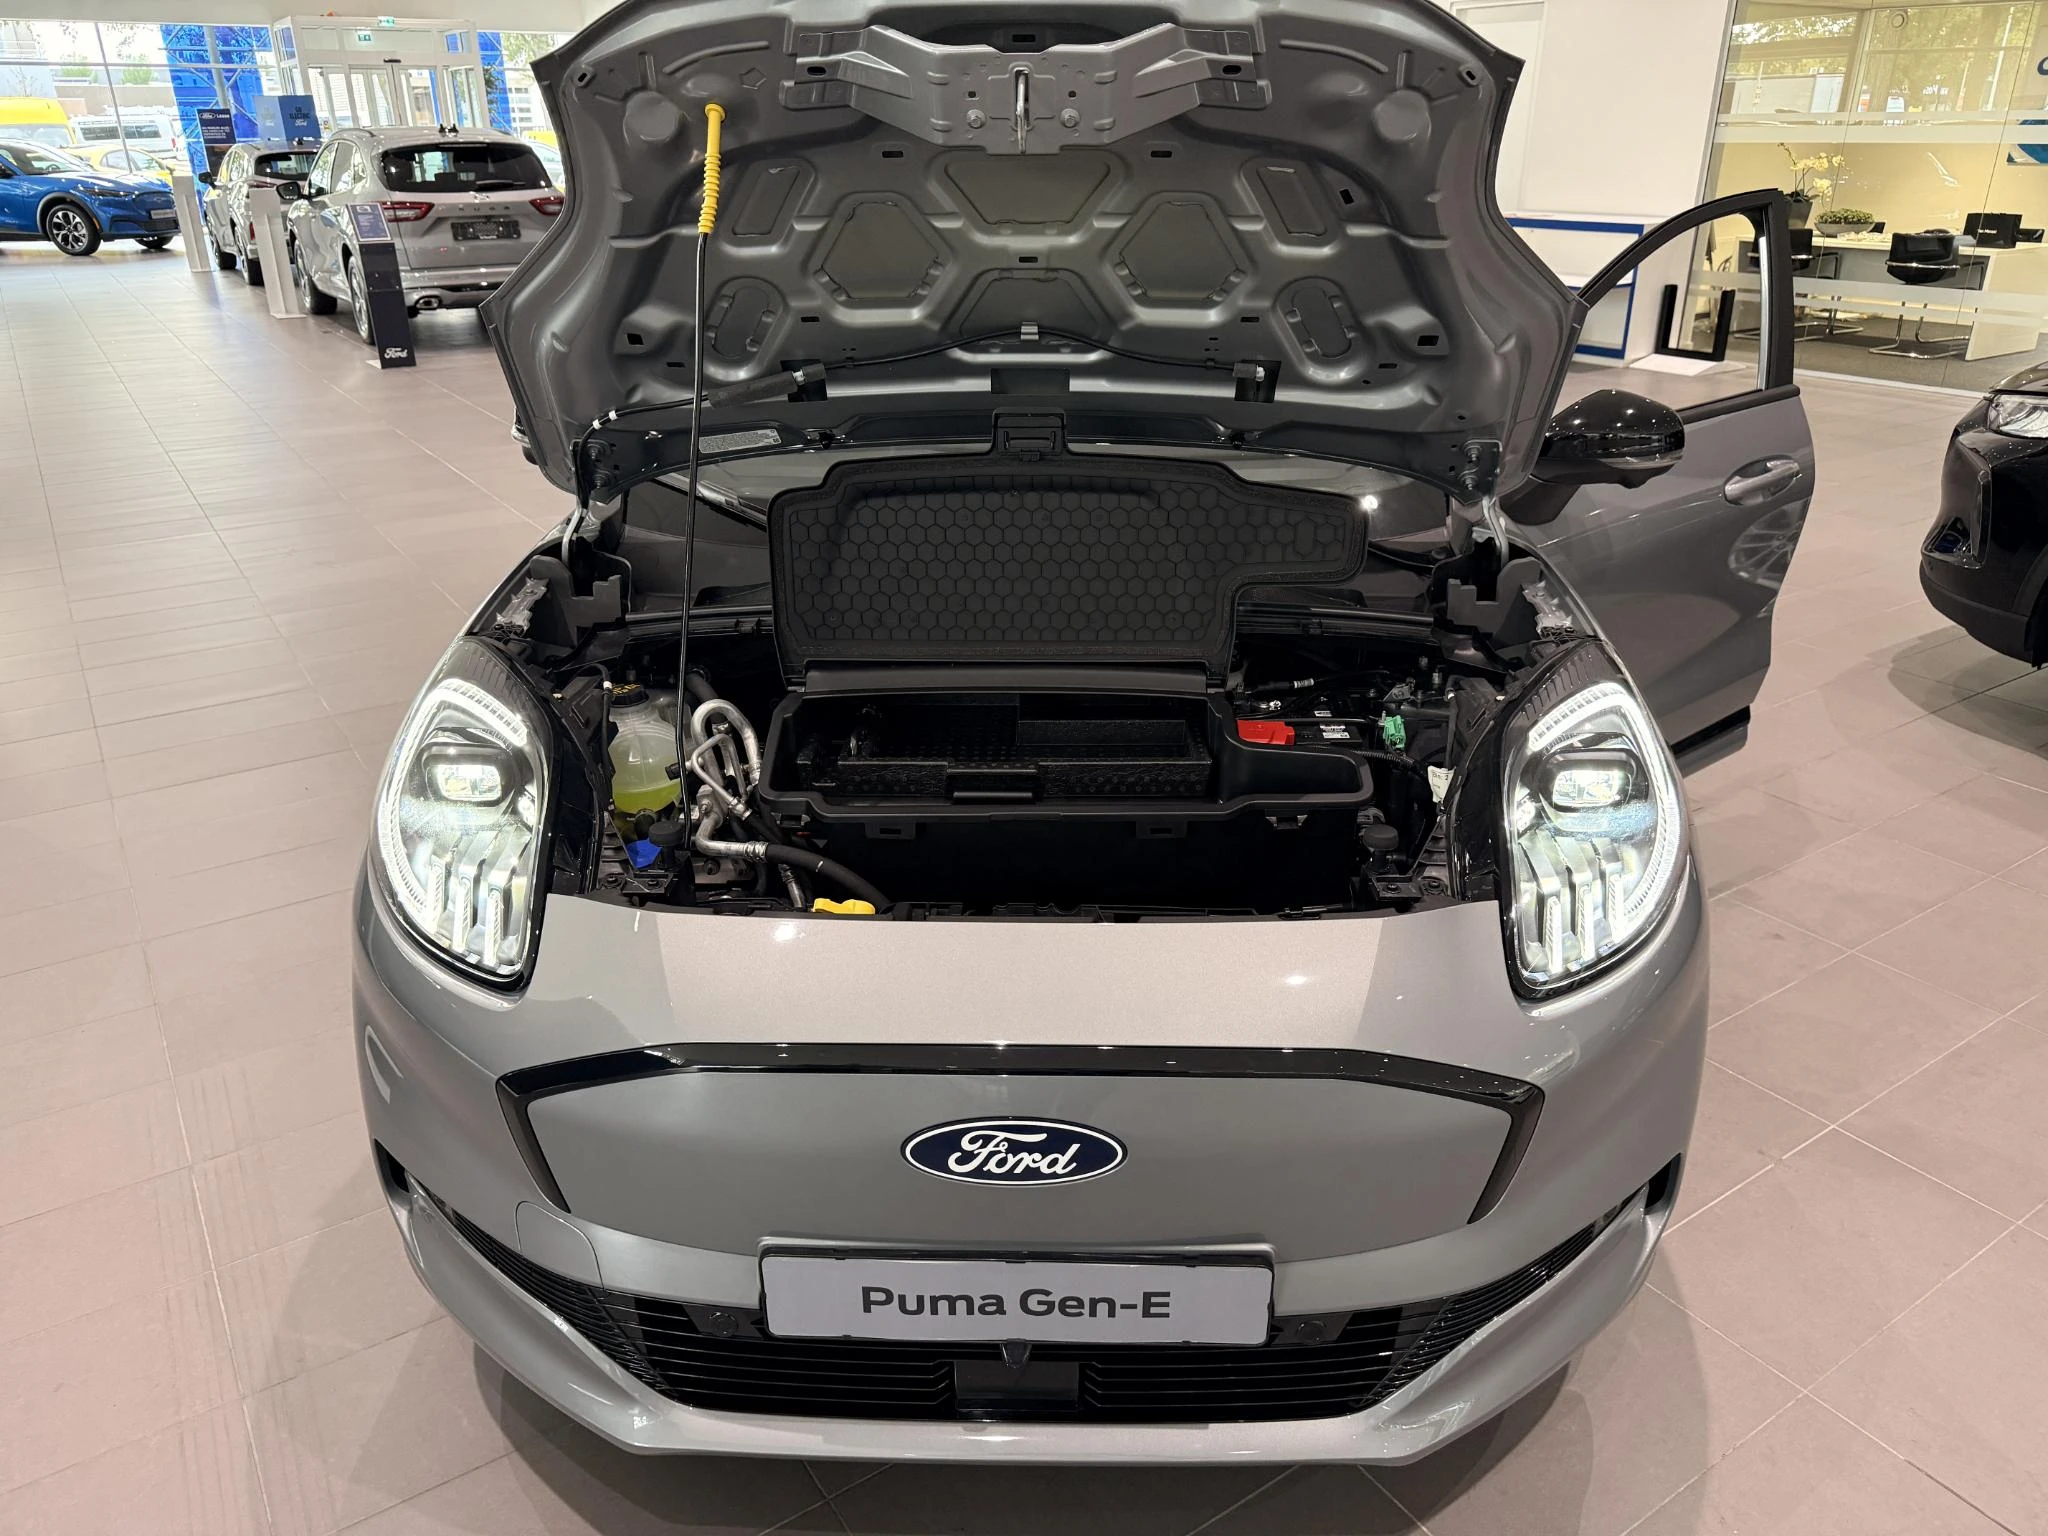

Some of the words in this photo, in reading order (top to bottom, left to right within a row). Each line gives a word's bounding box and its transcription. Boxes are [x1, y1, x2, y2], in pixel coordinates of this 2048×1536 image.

[384, 347, 408, 358] Ford
[947, 1129, 1081, 1175] Ford
[861, 1286, 1006, 1318] Puma
[1019, 1288, 1172, 1319] Gen-E
